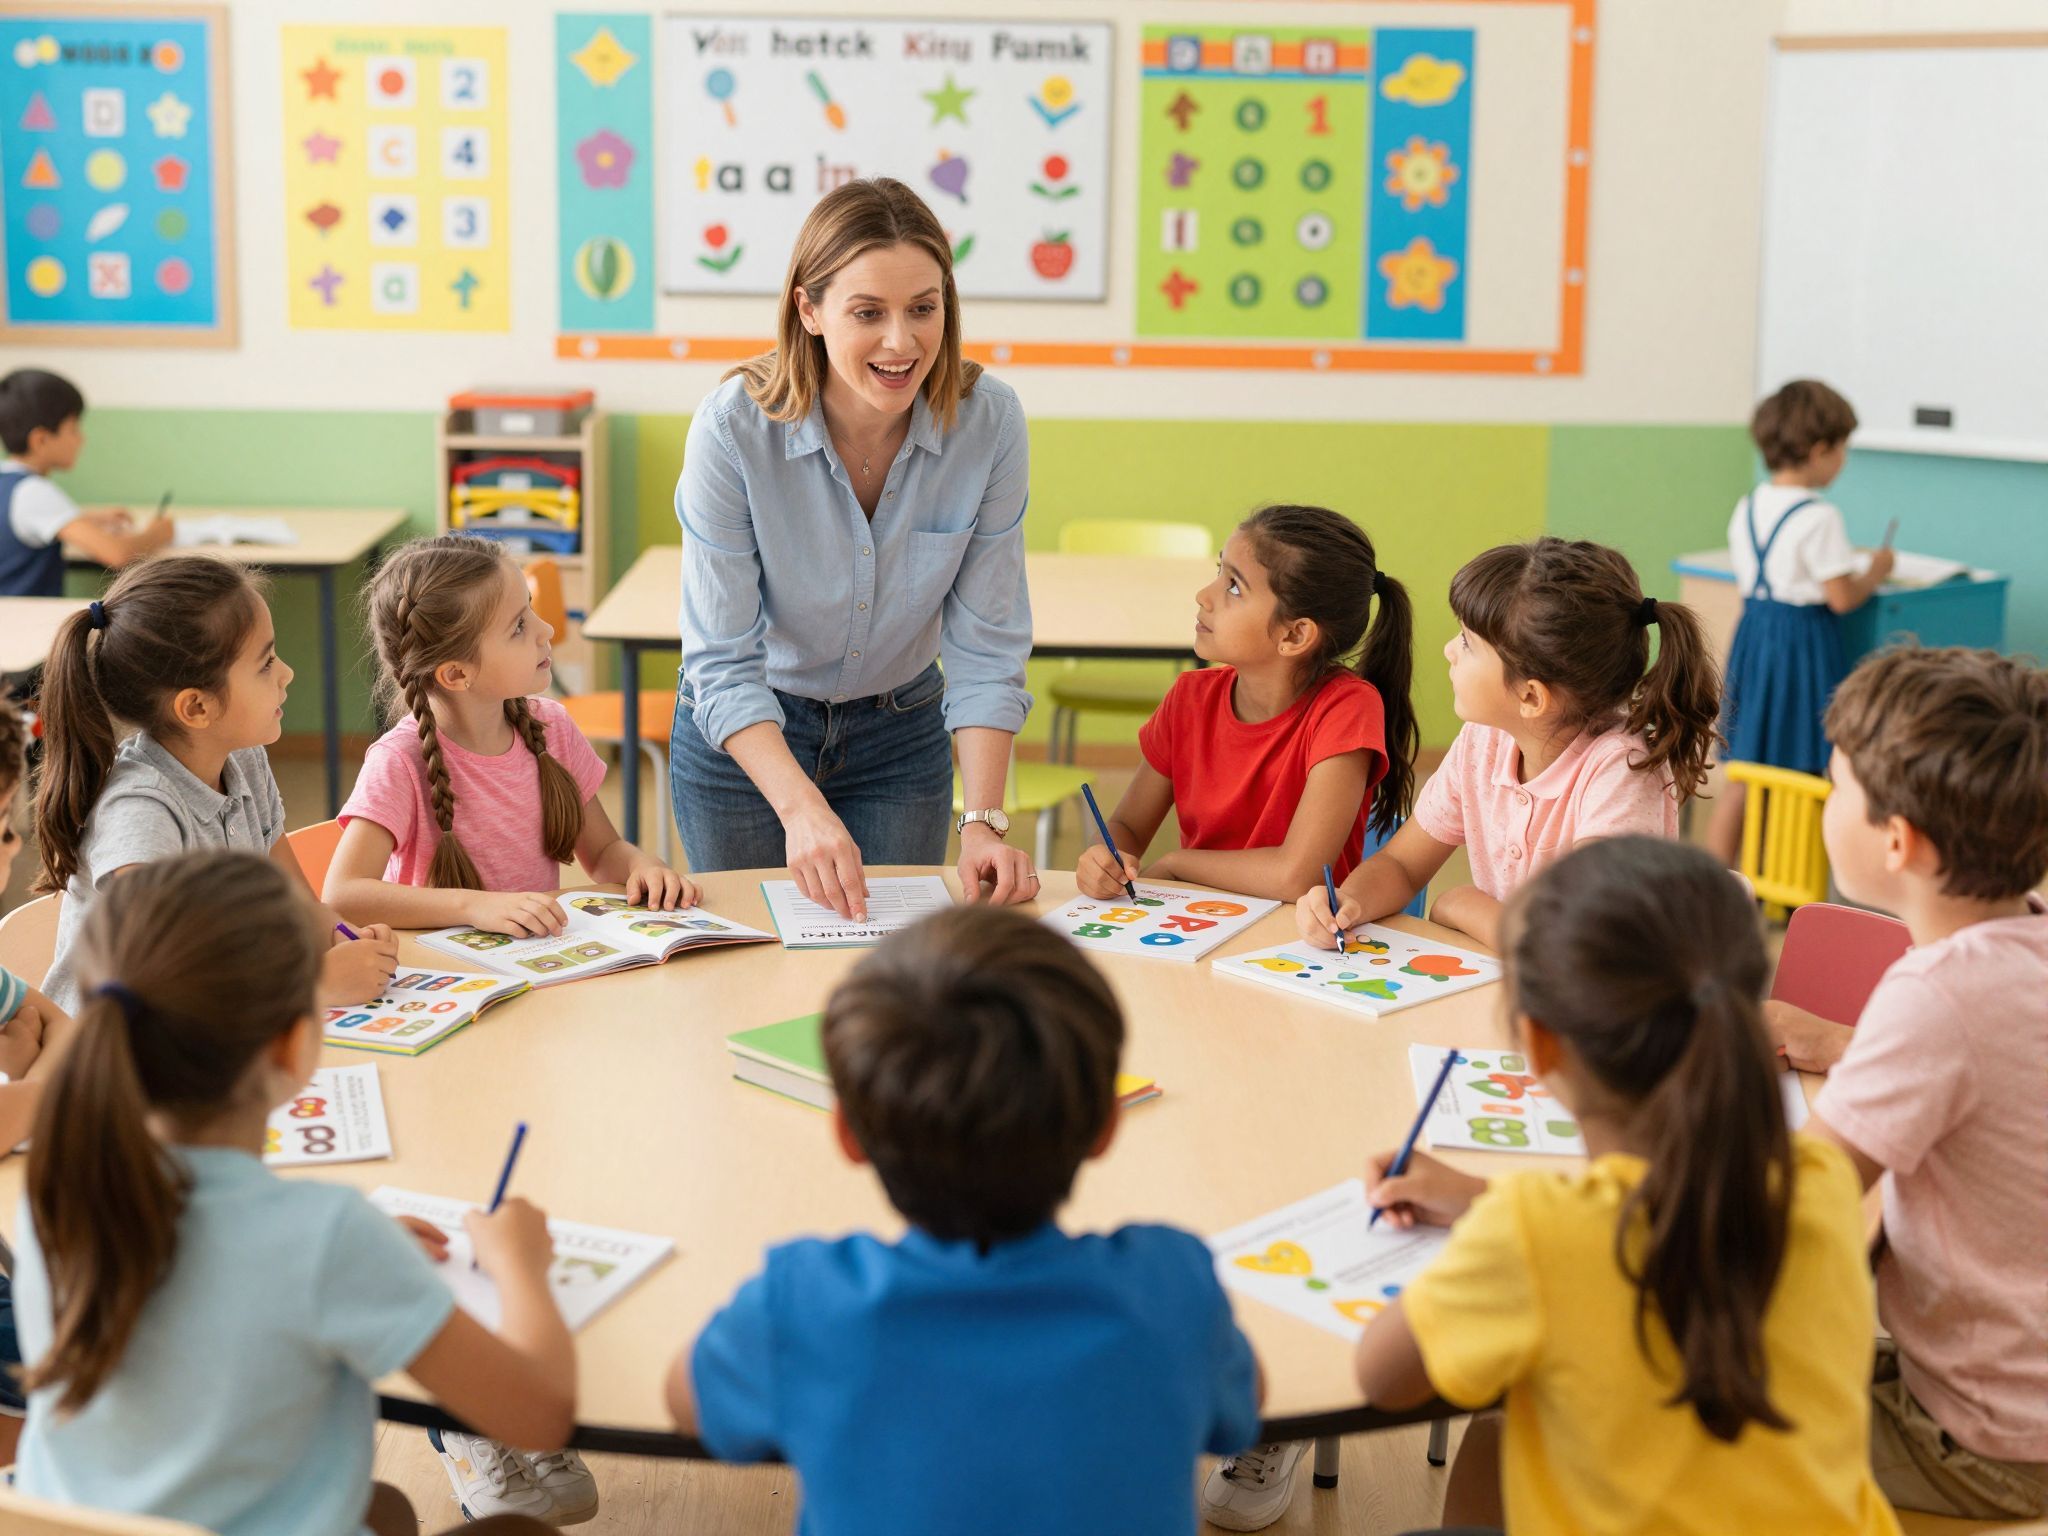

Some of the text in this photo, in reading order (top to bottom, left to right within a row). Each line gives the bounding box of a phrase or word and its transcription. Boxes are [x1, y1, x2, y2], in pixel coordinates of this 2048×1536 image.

[453, 67, 476, 100] 2
[452, 137, 476, 166] 4
[454, 206, 477, 238] 3
